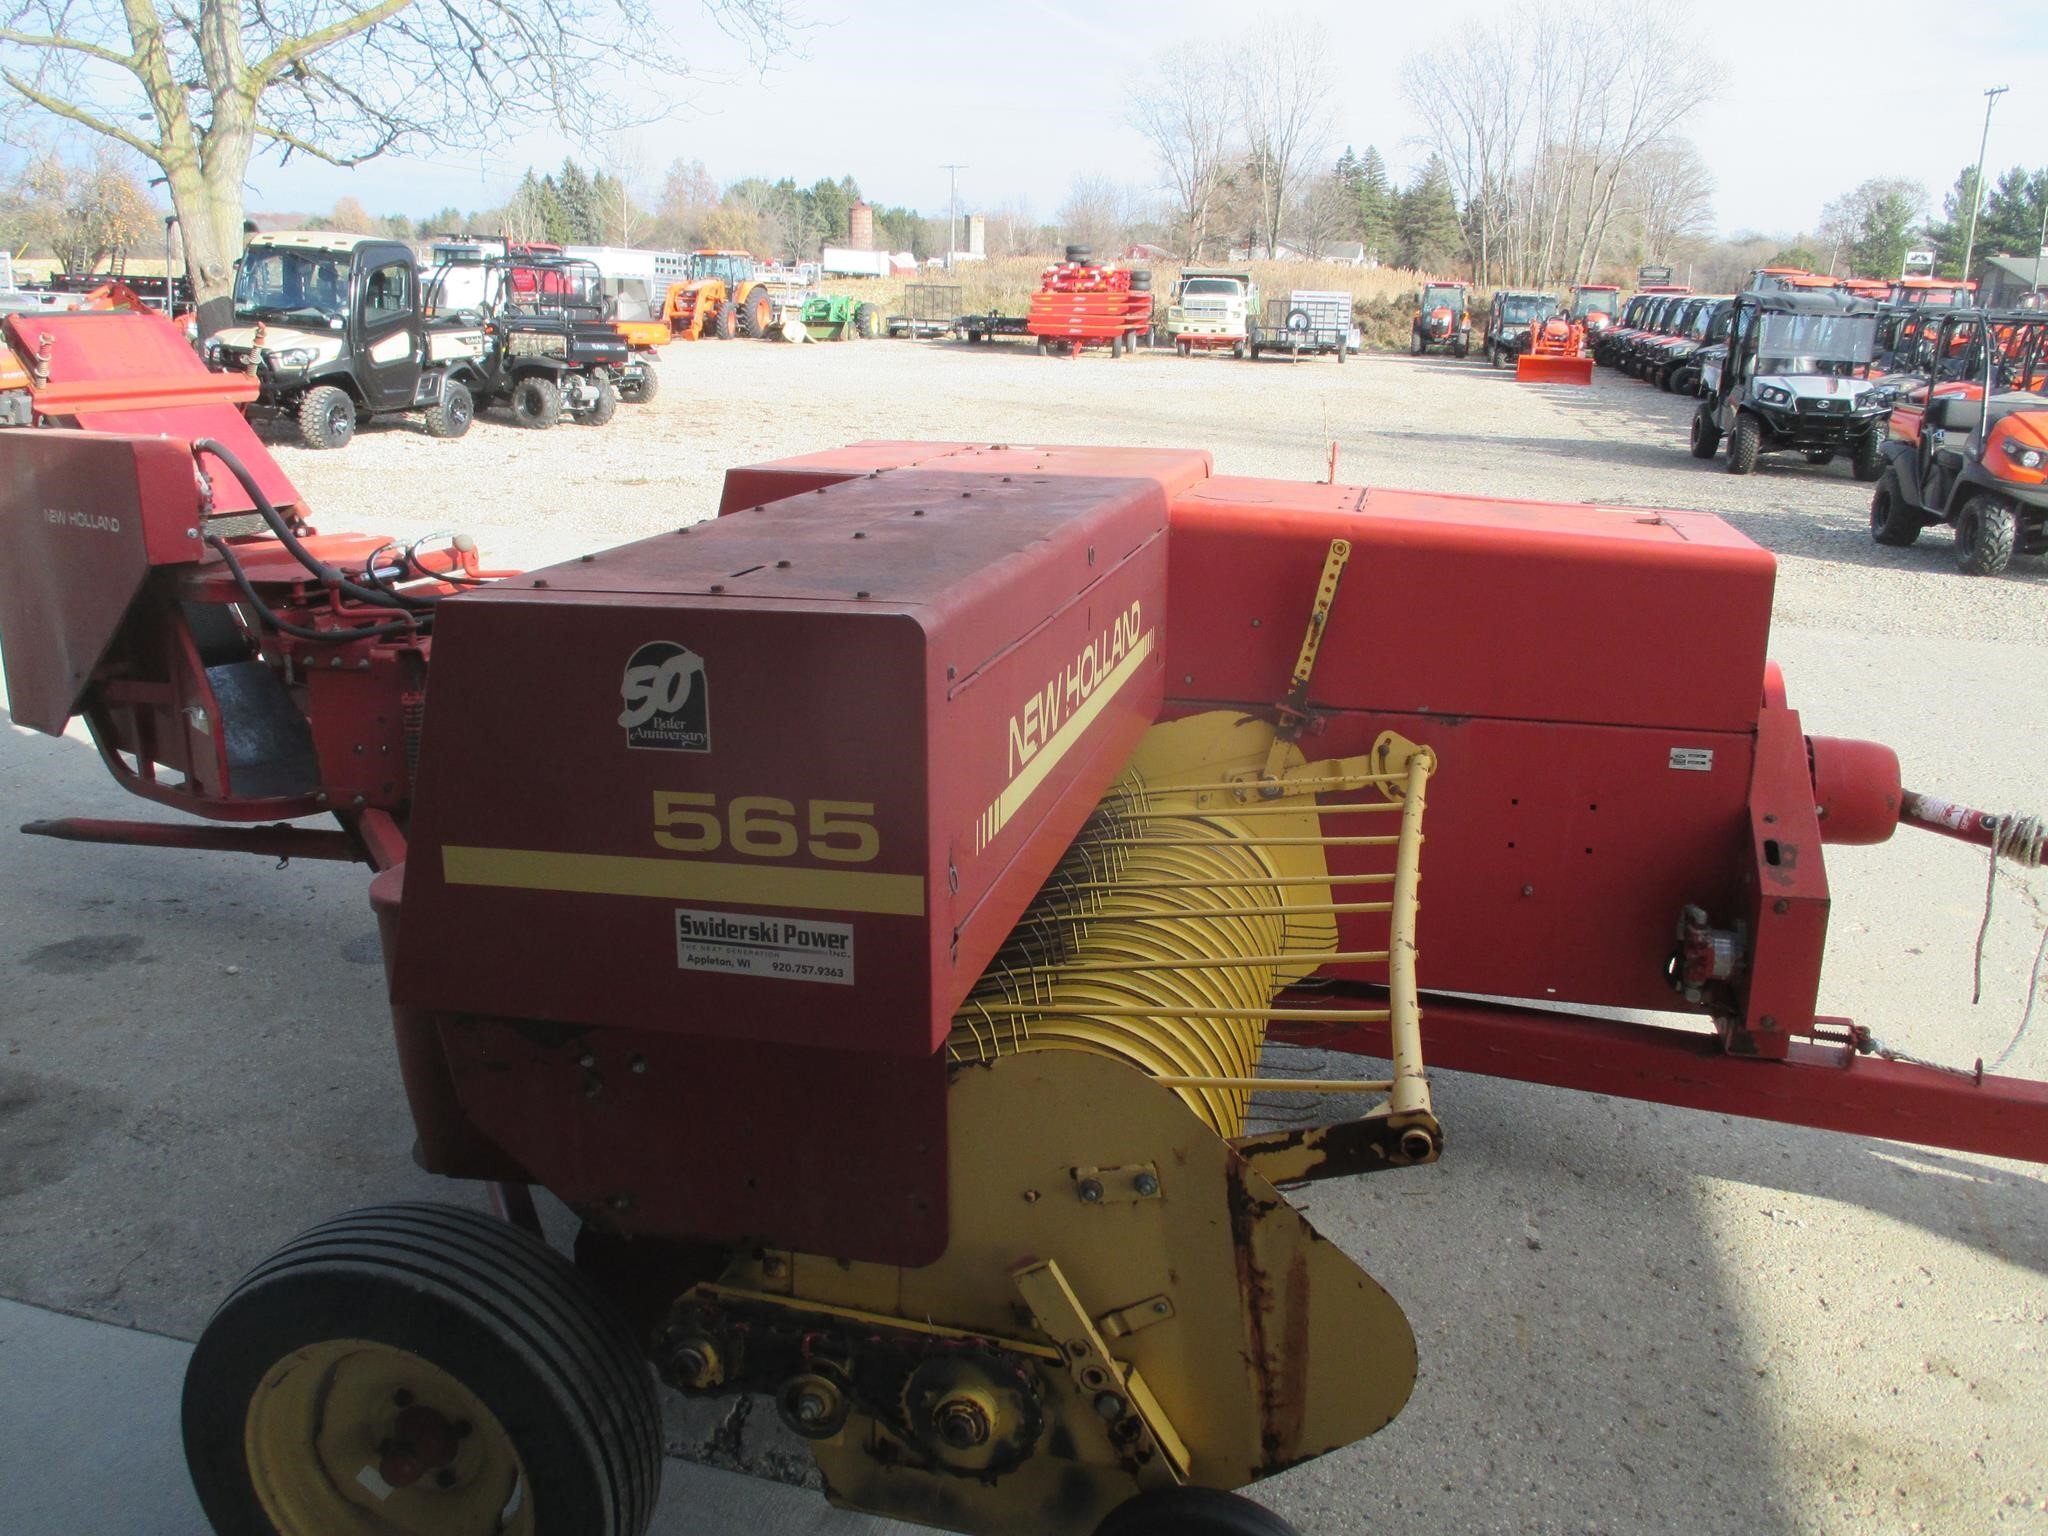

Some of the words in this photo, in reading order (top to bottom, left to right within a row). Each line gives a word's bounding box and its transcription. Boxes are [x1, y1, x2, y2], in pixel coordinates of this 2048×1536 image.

[69, 511, 120, 533] HOLLAND
[617, 650, 704, 729] 50
[1008, 671, 1063, 778] NEW
[1065, 598, 1142, 718] HOLLAND
[653, 716, 687, 731] Baler
[630, 728, 708, 747] Anniversary
[653, 790, 880, 862] 565
[680, 914, 778, 943] Swiderski
[784, 924, 849, 950] Power
[686, 954, 734, 968] Appleton,
[737, 959, 751, 968] WI
[772, 962, 844, 978] 920.757.9363
